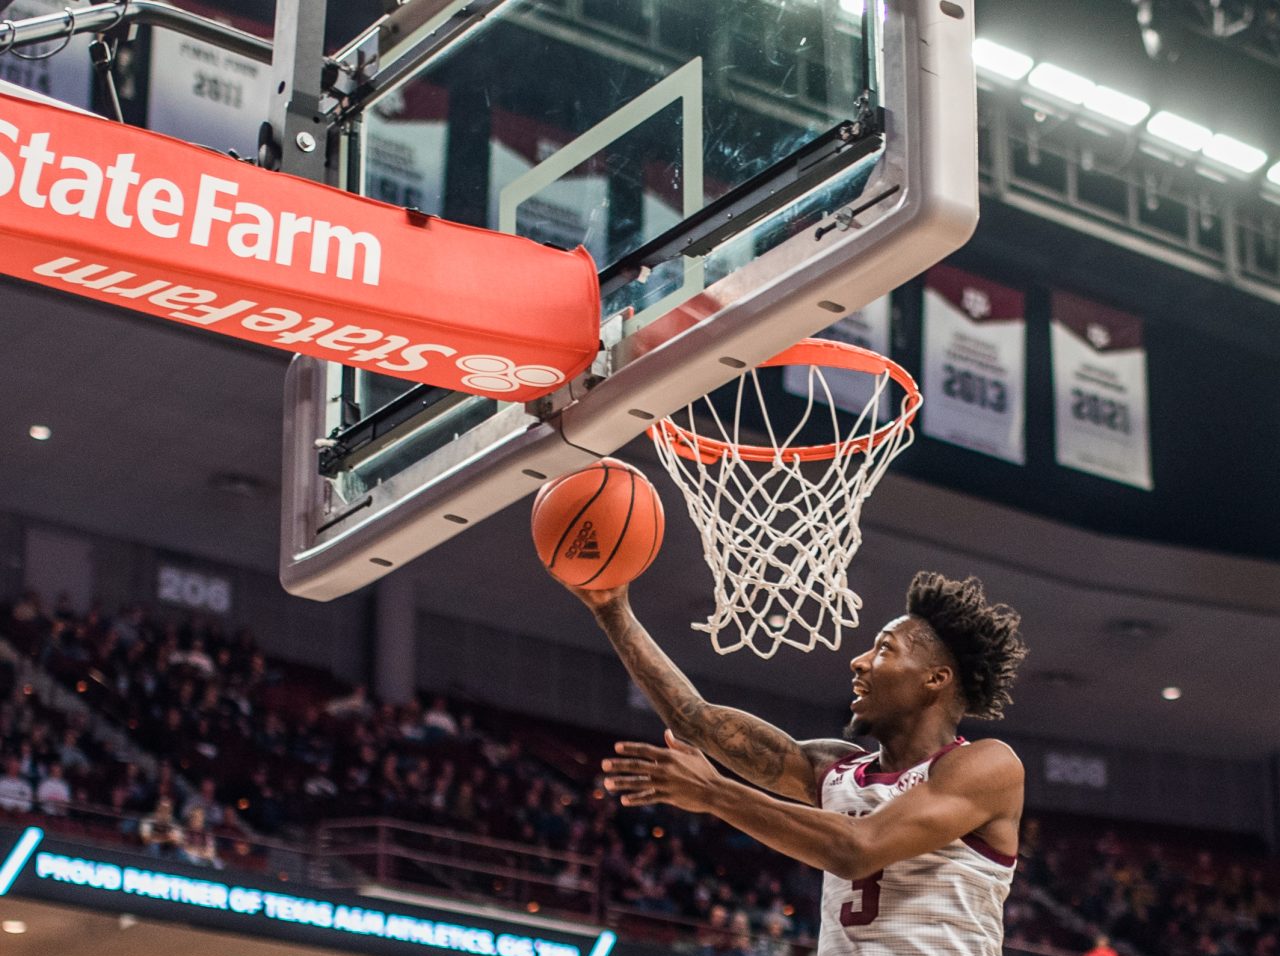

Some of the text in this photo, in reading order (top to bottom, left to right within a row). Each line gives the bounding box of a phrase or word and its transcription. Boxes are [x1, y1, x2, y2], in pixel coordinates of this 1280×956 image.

[942, 362, 1007, 414] 2013
[36, 852, 122, 891] PROUD
[122, 866, 230, 910] PARTNER
[229, 885, 263, 914] OF
[263, 891, 334, 928] TEXAS
